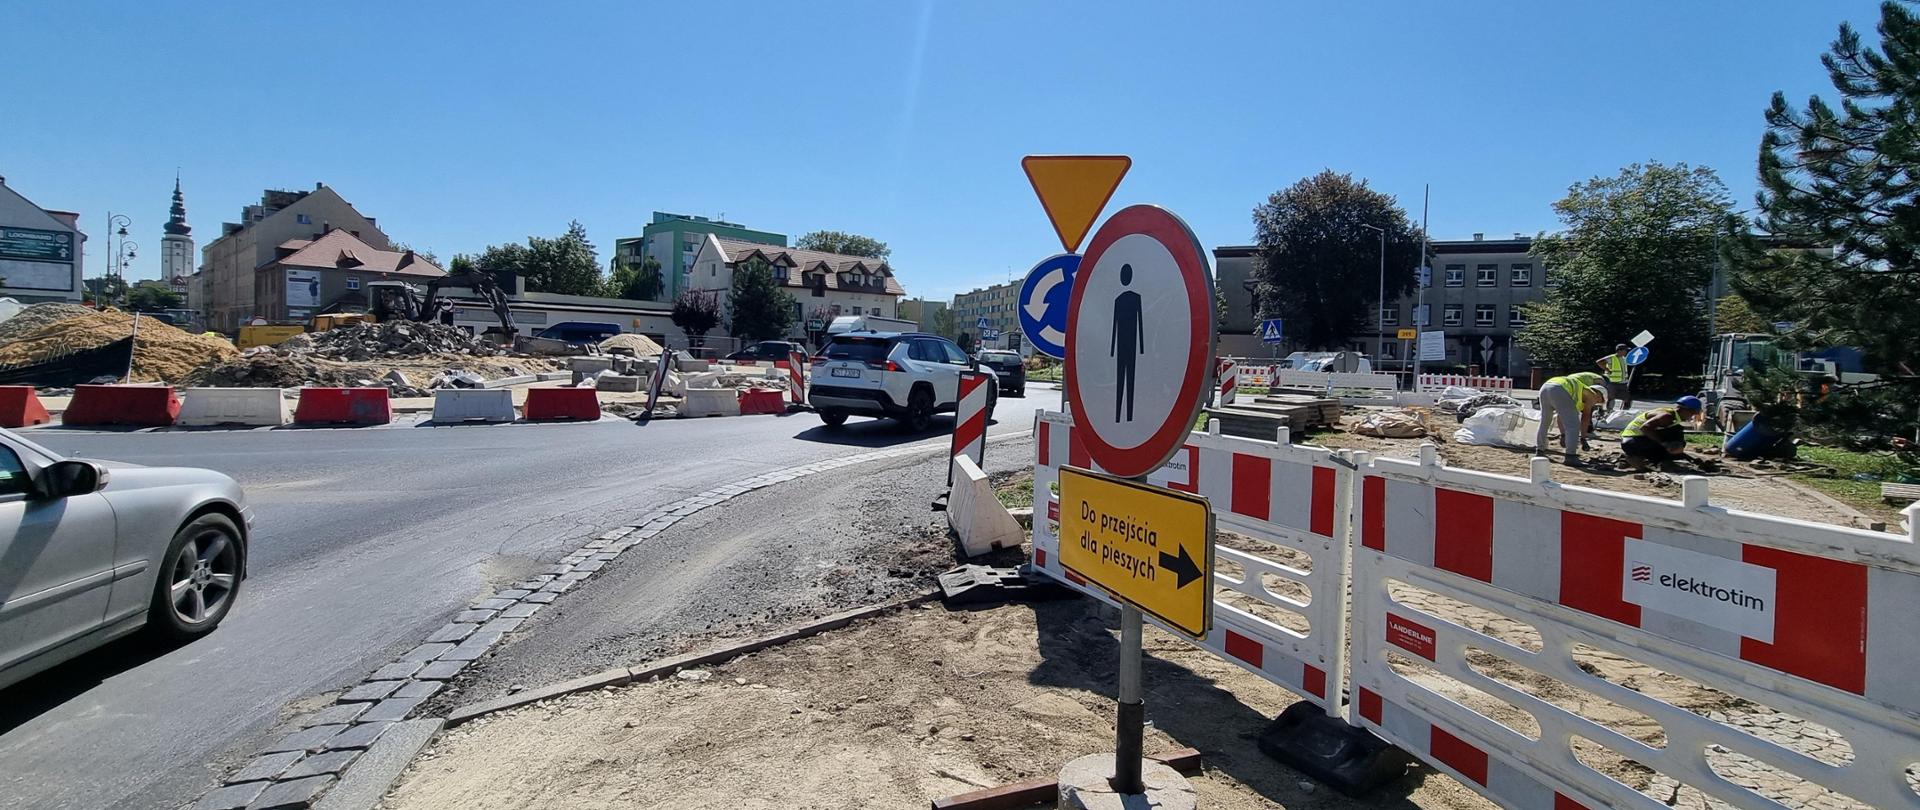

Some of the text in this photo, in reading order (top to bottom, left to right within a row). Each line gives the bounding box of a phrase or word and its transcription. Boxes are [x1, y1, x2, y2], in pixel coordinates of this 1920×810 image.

[1081, 500, 1157, 547] Do przejścia
[1080, 530, 1155, 581] dla pieszych
[1660, 573, 1764, 611] elektrotim
